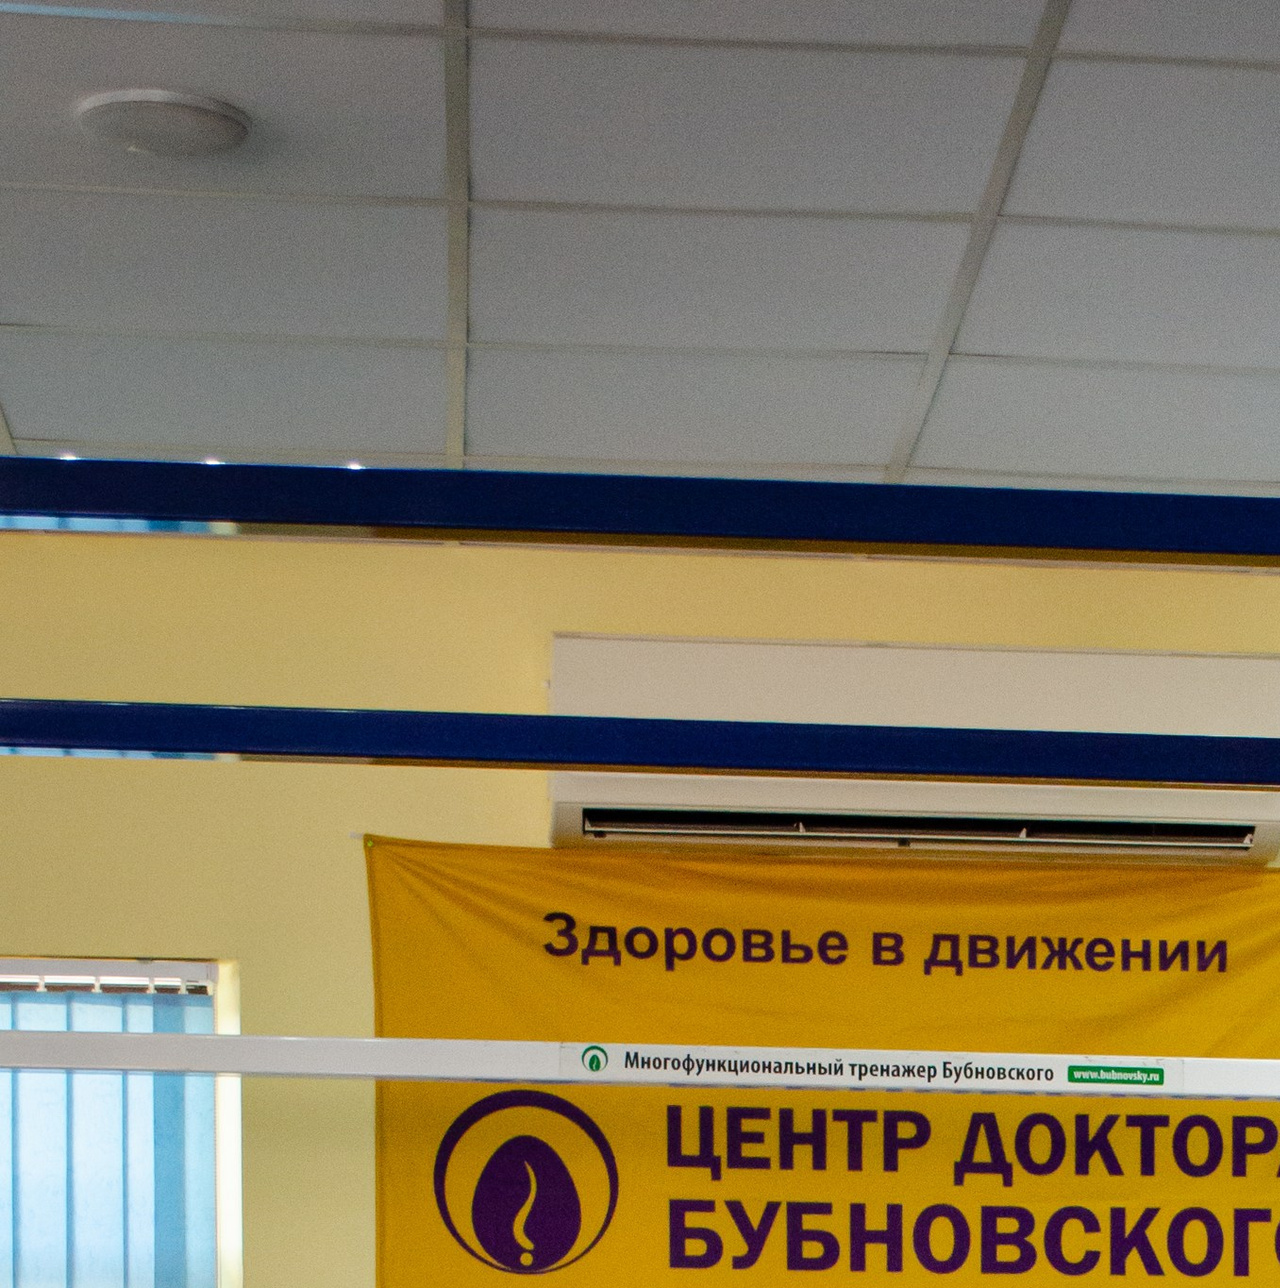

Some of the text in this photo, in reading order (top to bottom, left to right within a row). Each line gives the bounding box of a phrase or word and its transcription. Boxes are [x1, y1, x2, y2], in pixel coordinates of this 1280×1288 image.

[543, 911, 1228, 976] Здоровье в движении
[624, 1051, 1055, 1084] Многофункциональный тренажер Бубновского
[1073, 1068, 1161, 1084] www.bubnovsky.ru
[667, 1105, 932, 1181] ЦЕНТР
